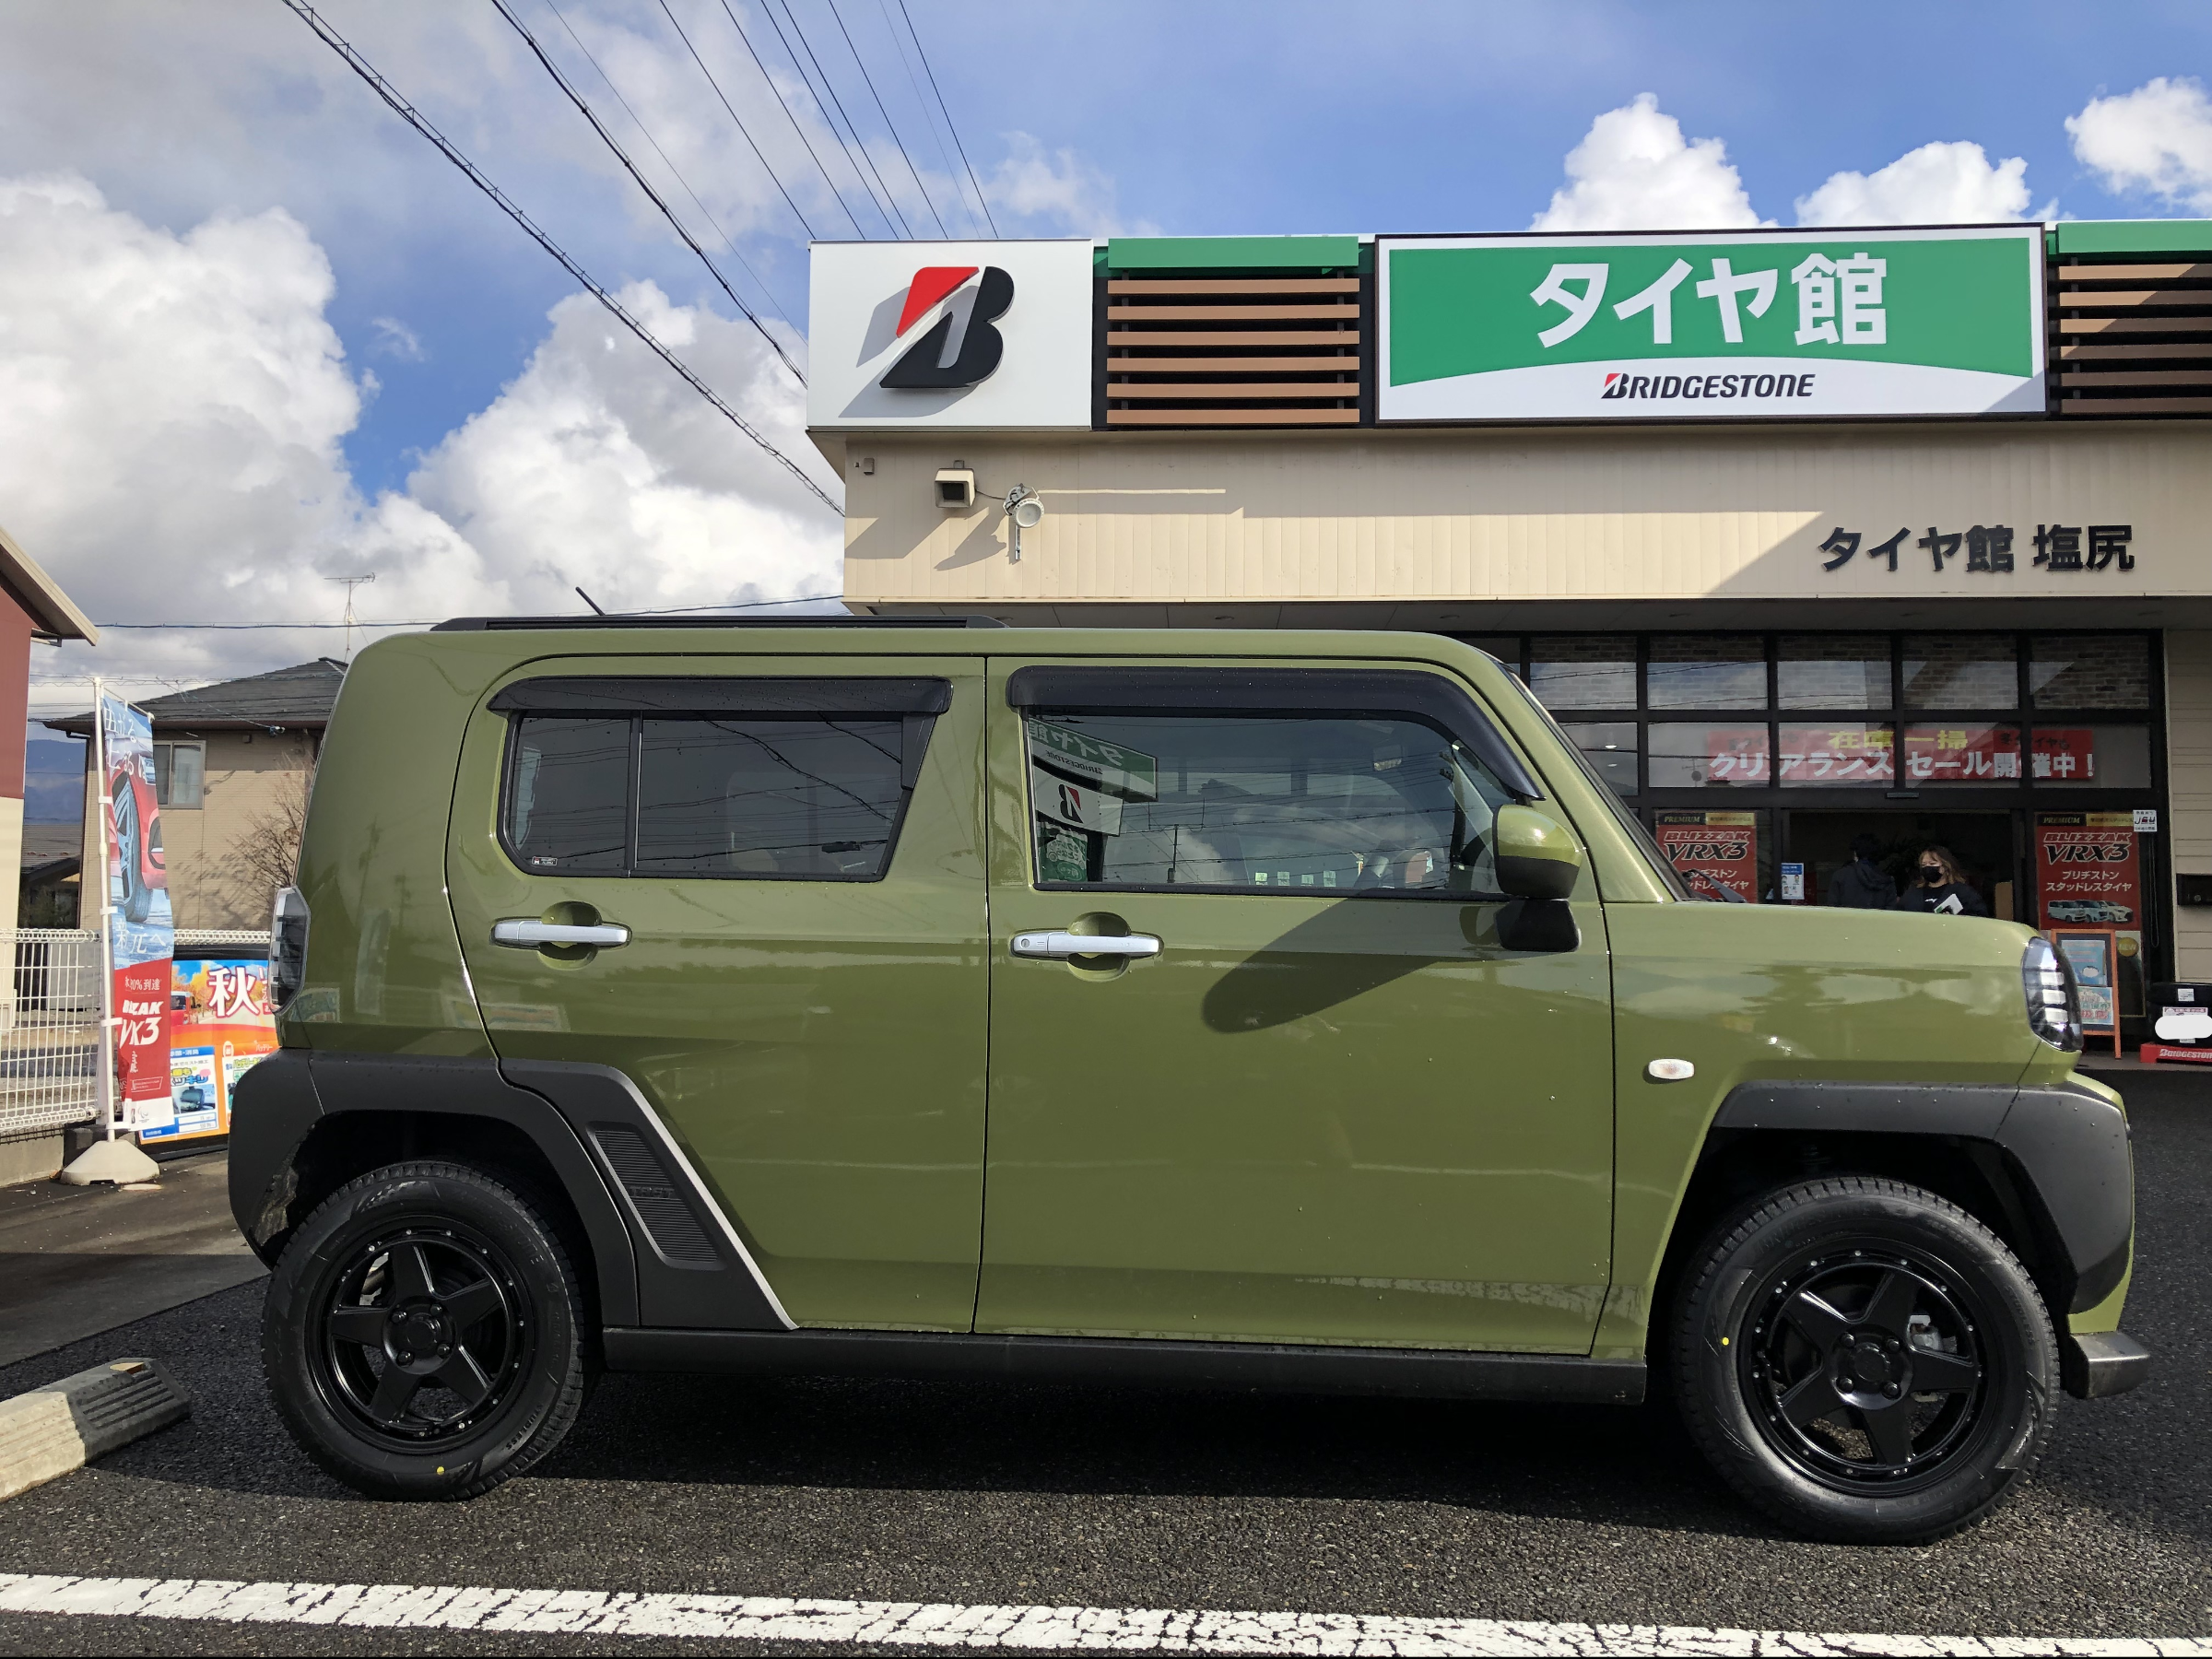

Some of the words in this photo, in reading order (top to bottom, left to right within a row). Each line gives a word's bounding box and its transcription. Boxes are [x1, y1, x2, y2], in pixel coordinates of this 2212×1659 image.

[1530, 252, 1888, 348] タイヤ館
[1601, 372, 1816, 399] BRIDGESTONE
[1818, 524, 2014, 572] タイヤ館
[2032, 524, 2136, 572] 塩尻
[1828, 730, 1969, 750] 在庫一掃
[1664, 831, 1751, 842] BLIZZAK
[2042, 831, 2133, 843] BLIZZAK
[1664, 841, 1750, 863] VRX3
[2042, 841, 2133, 865] VRX3
[2062, 870, 2120, 880] ブリヂストン
[2045, 882, 2133, 892] スタッドレスタイヤ
[208, 967, 260, 1017] 秋
